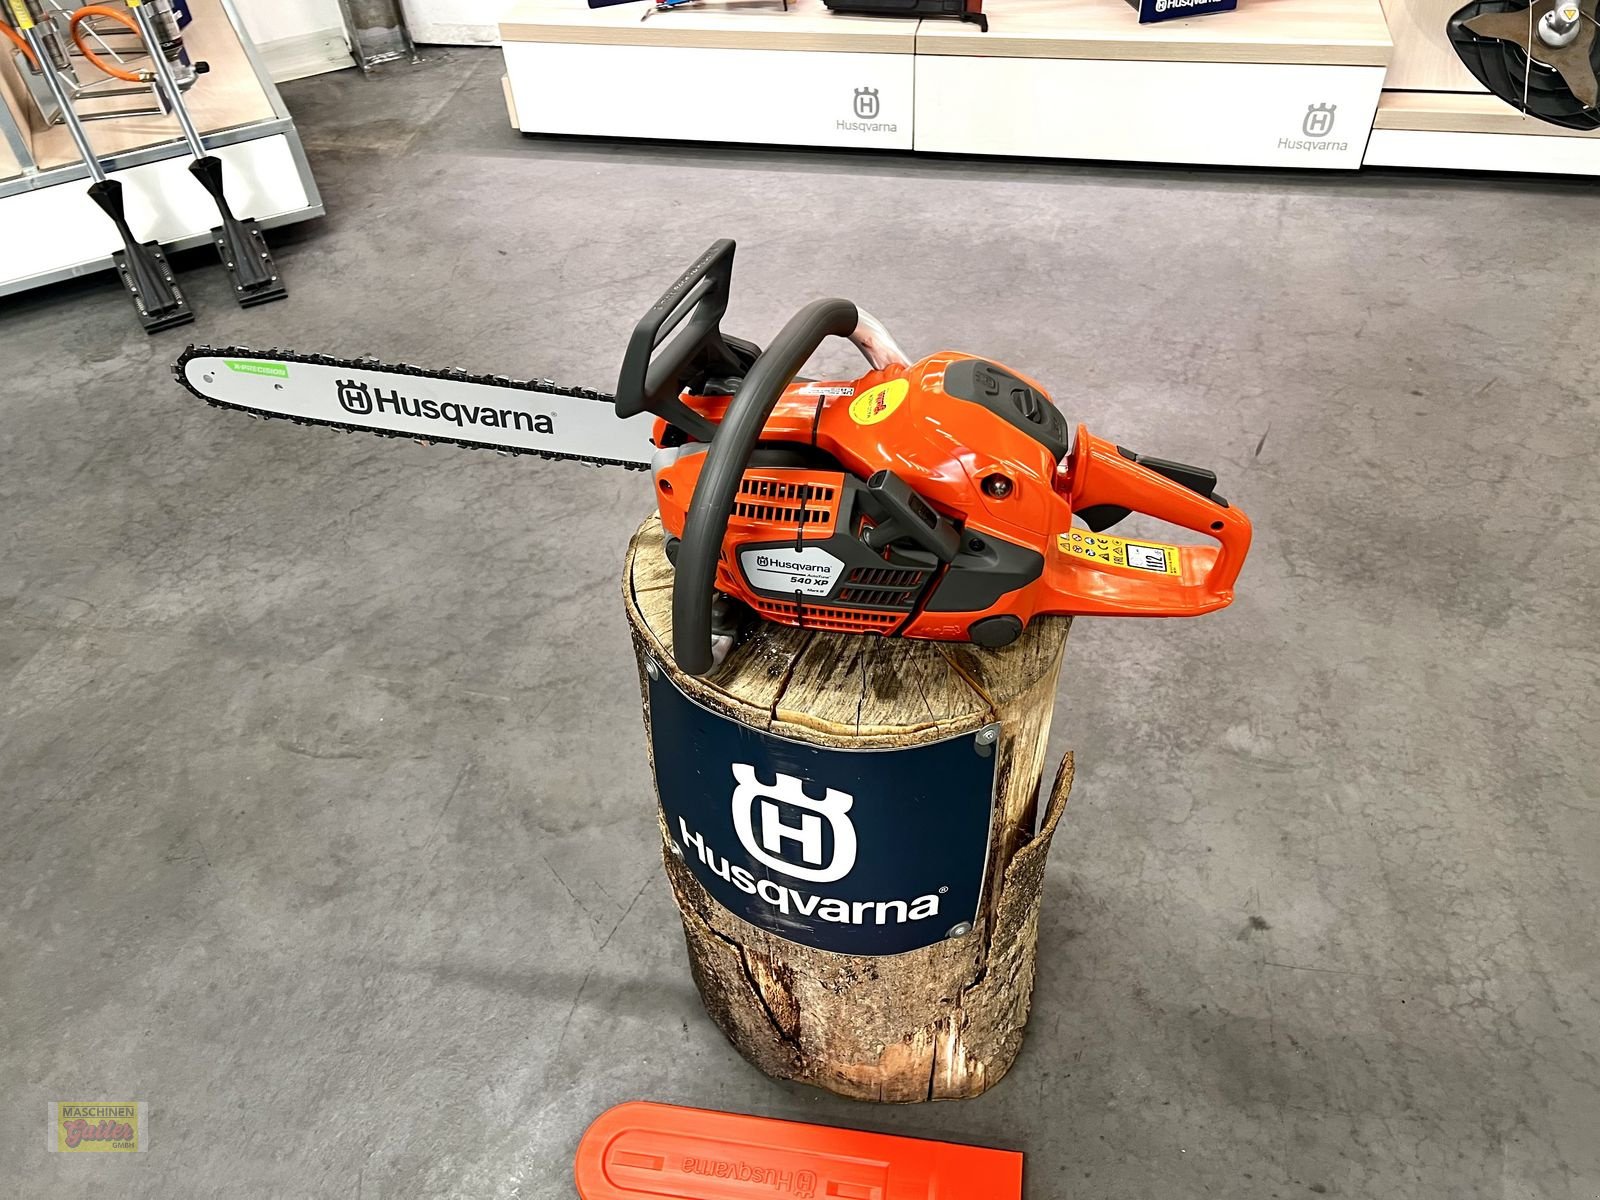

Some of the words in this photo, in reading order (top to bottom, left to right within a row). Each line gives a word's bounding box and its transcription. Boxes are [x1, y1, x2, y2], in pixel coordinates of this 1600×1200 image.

[836, 119, 898, 132] Husqvarna
[1277, 137, 1348, 151] Husqvarna
[769, 558, 831, 573] Husqvarna
[1145, 555, 1164, 569] 112
[790, 576, 812, 585] 540
[682, 1157, 793, 1193] Husqvarna
